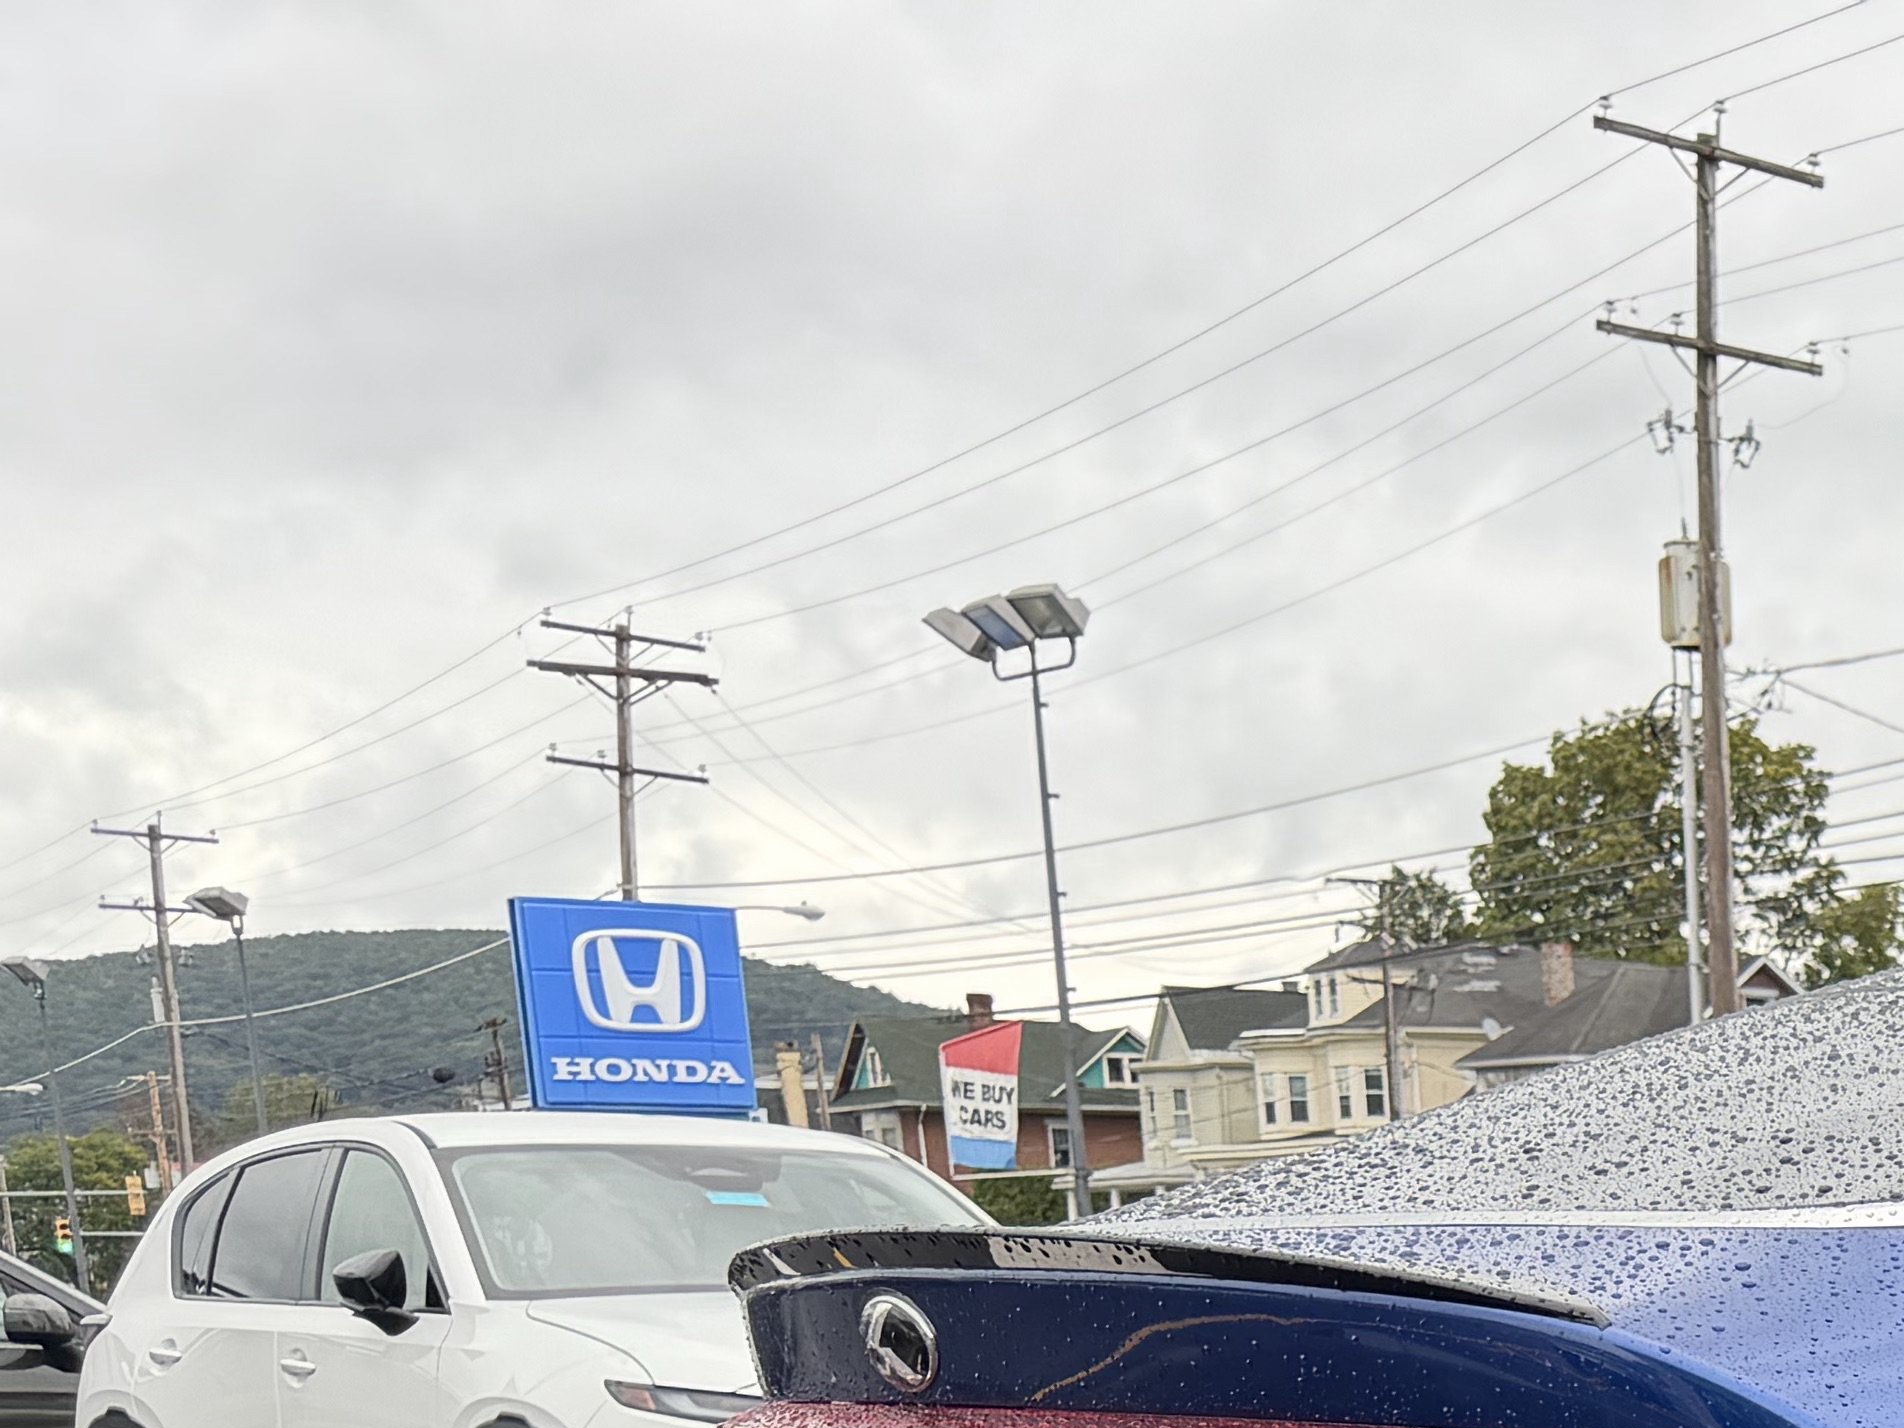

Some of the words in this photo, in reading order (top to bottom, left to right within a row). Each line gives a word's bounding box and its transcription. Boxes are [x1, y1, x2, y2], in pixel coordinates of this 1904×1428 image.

[551, 1056, 746, 1086] HONDA
[981, 1083, 1015, 1105] BUY
[959, 1105, 1007, 1130] CARS
